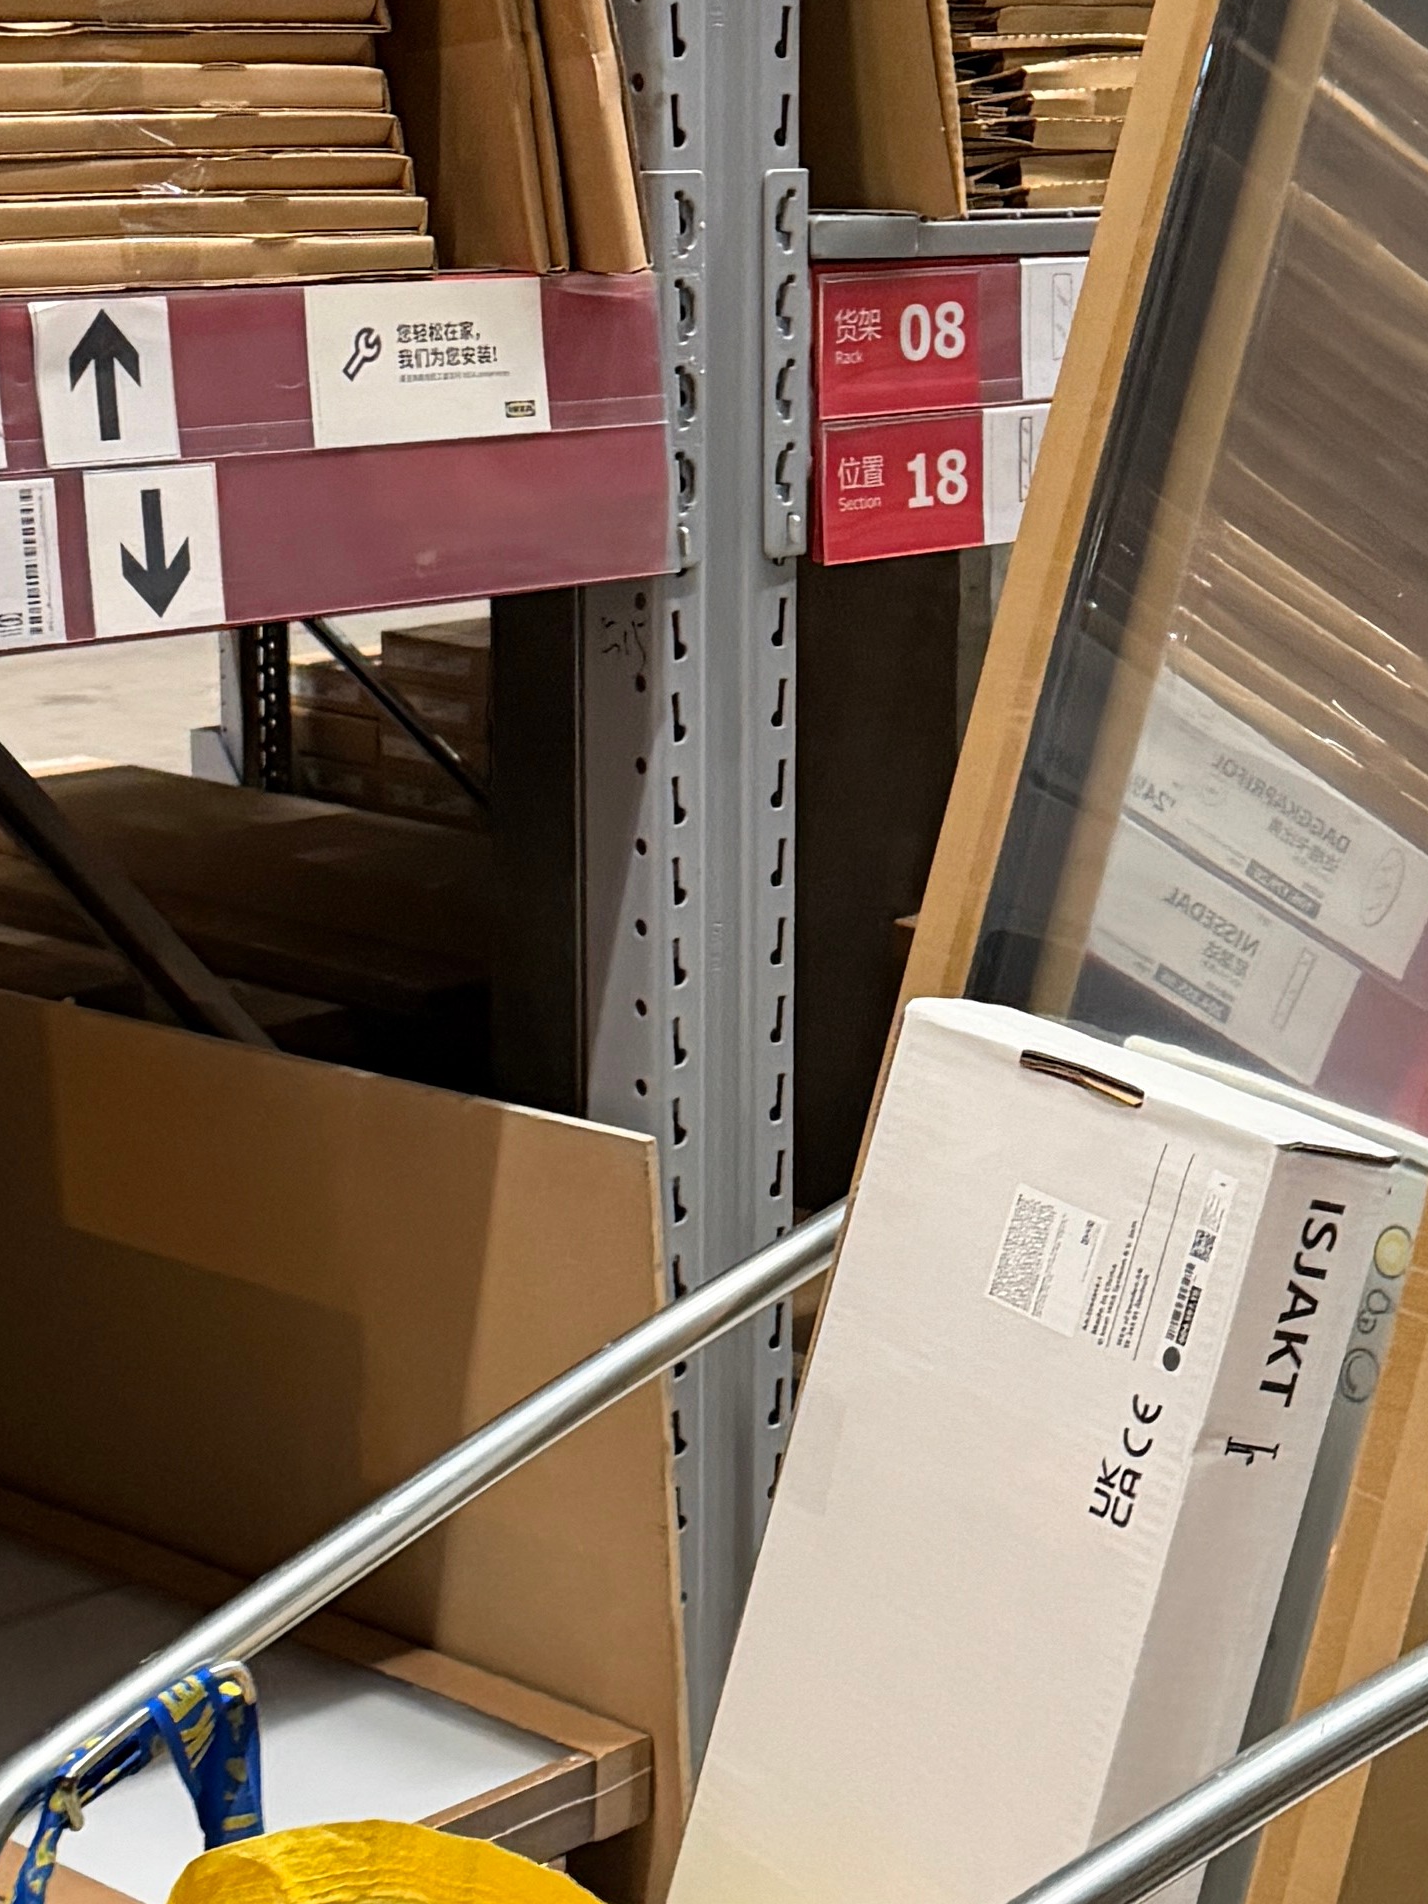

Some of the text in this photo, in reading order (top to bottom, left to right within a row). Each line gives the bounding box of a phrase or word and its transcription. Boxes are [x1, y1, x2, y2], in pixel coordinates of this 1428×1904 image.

[835, 307, 882, 344] 货架
[899, 300, 966, 362] 08
[835, 350, 864, 365] Rack
[837, 454, 885, 491] 位置
[907, 448, 968, 509] 18
[838, 497, 881, 512] Section
[1259, 1199, 1346, 1408] ISJAKT
[1123, 1394, 1163, 1457] CE
[1088, 1457, 1123, 1518] UK
[1110, 1468, 1143, 1528] CA
